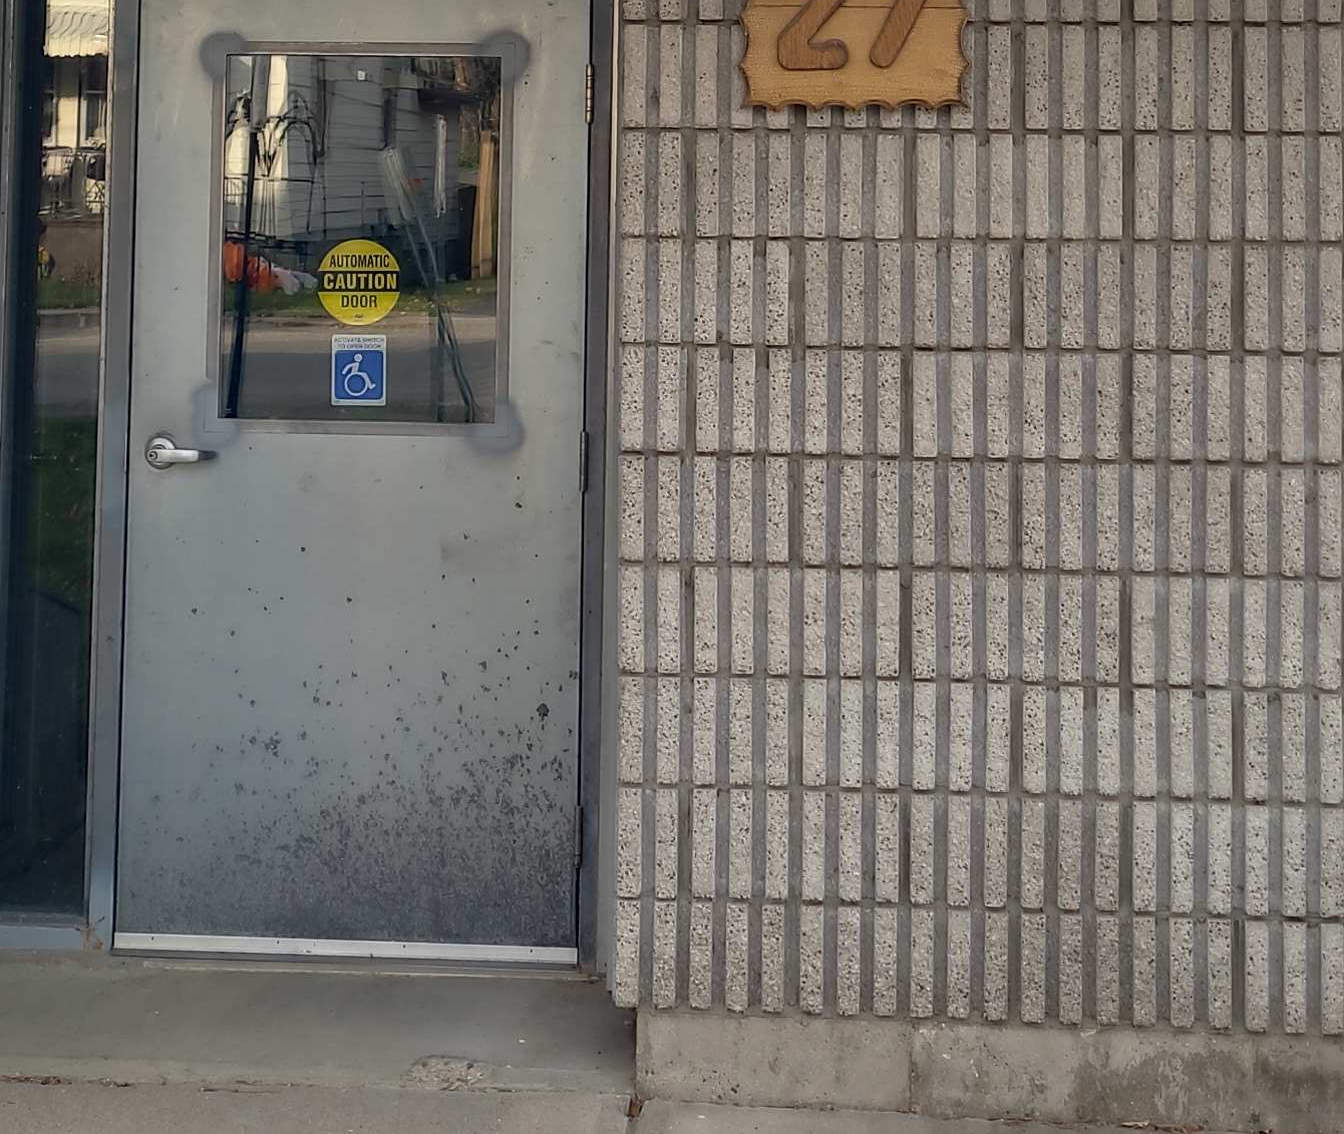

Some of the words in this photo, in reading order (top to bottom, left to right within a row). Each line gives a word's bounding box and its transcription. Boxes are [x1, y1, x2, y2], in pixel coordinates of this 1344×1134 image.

[329, 254, 390, 268] AUTOMATIC
[323, 273, 397, 290] CAUTION
[341, 294, 378, 308] DOOR
